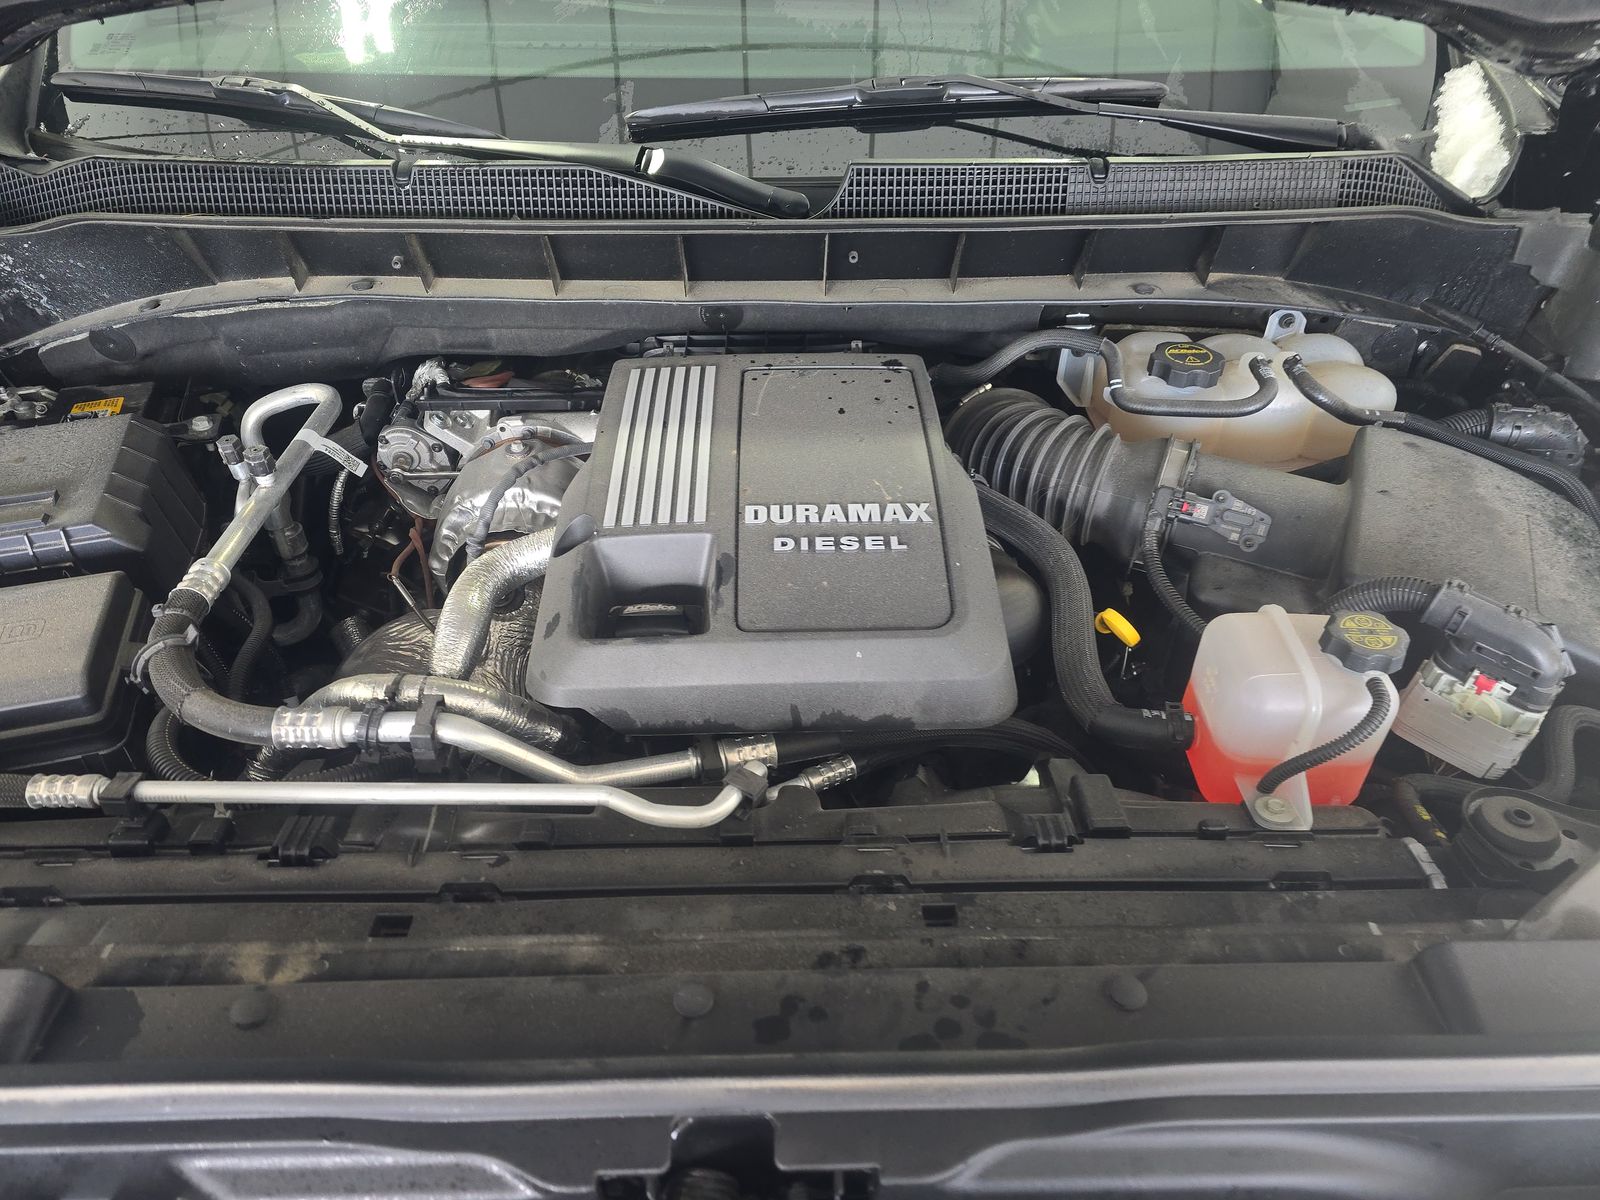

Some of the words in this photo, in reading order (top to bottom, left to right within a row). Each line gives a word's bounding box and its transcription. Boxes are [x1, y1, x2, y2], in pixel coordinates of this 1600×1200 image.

[744, 502, 934, 523] DURAMAX
[773, 535, 908, 552] DIESEL
[622, 603, 677, 615] ACDelco
